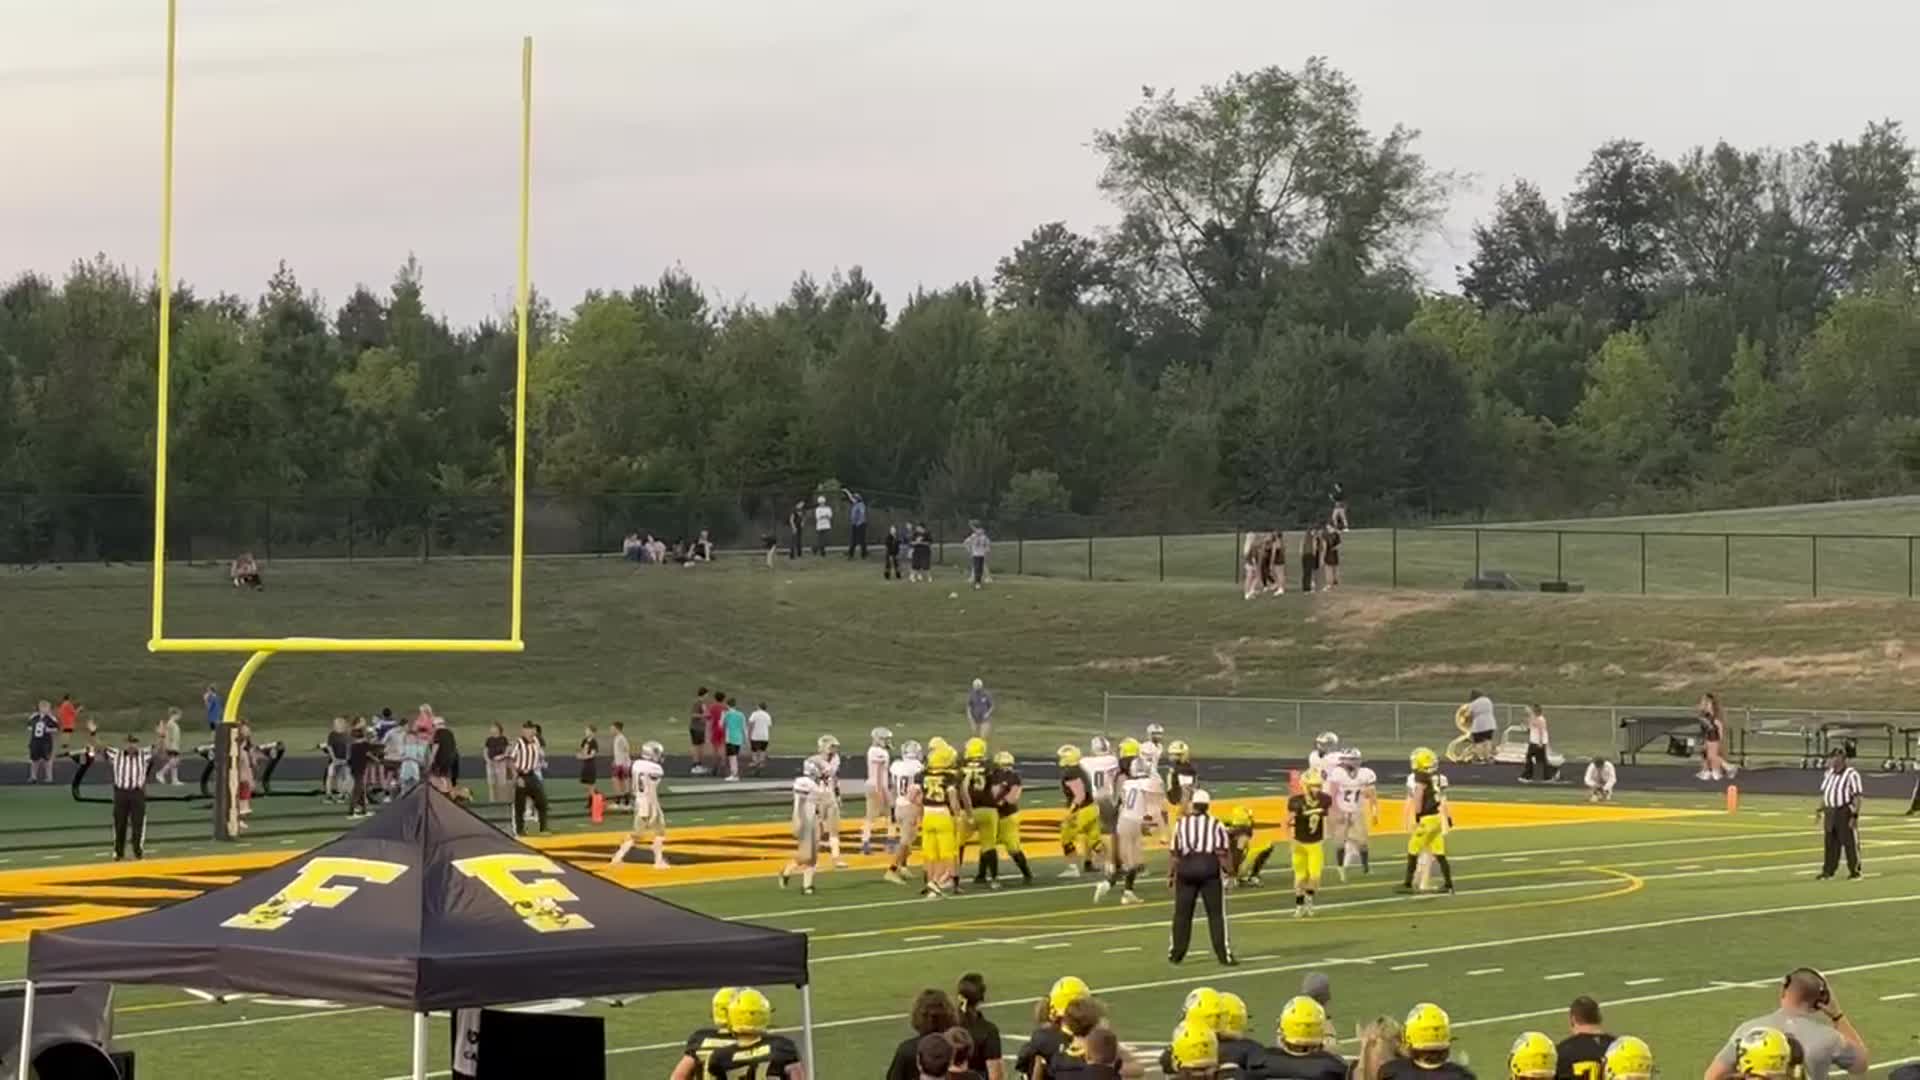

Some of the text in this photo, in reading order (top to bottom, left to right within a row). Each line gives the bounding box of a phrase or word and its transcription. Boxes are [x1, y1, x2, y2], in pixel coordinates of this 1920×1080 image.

[34, 721, 44, 737] 8
[220, 856, 409, 930] F
[451, 854, 595, 933] F
